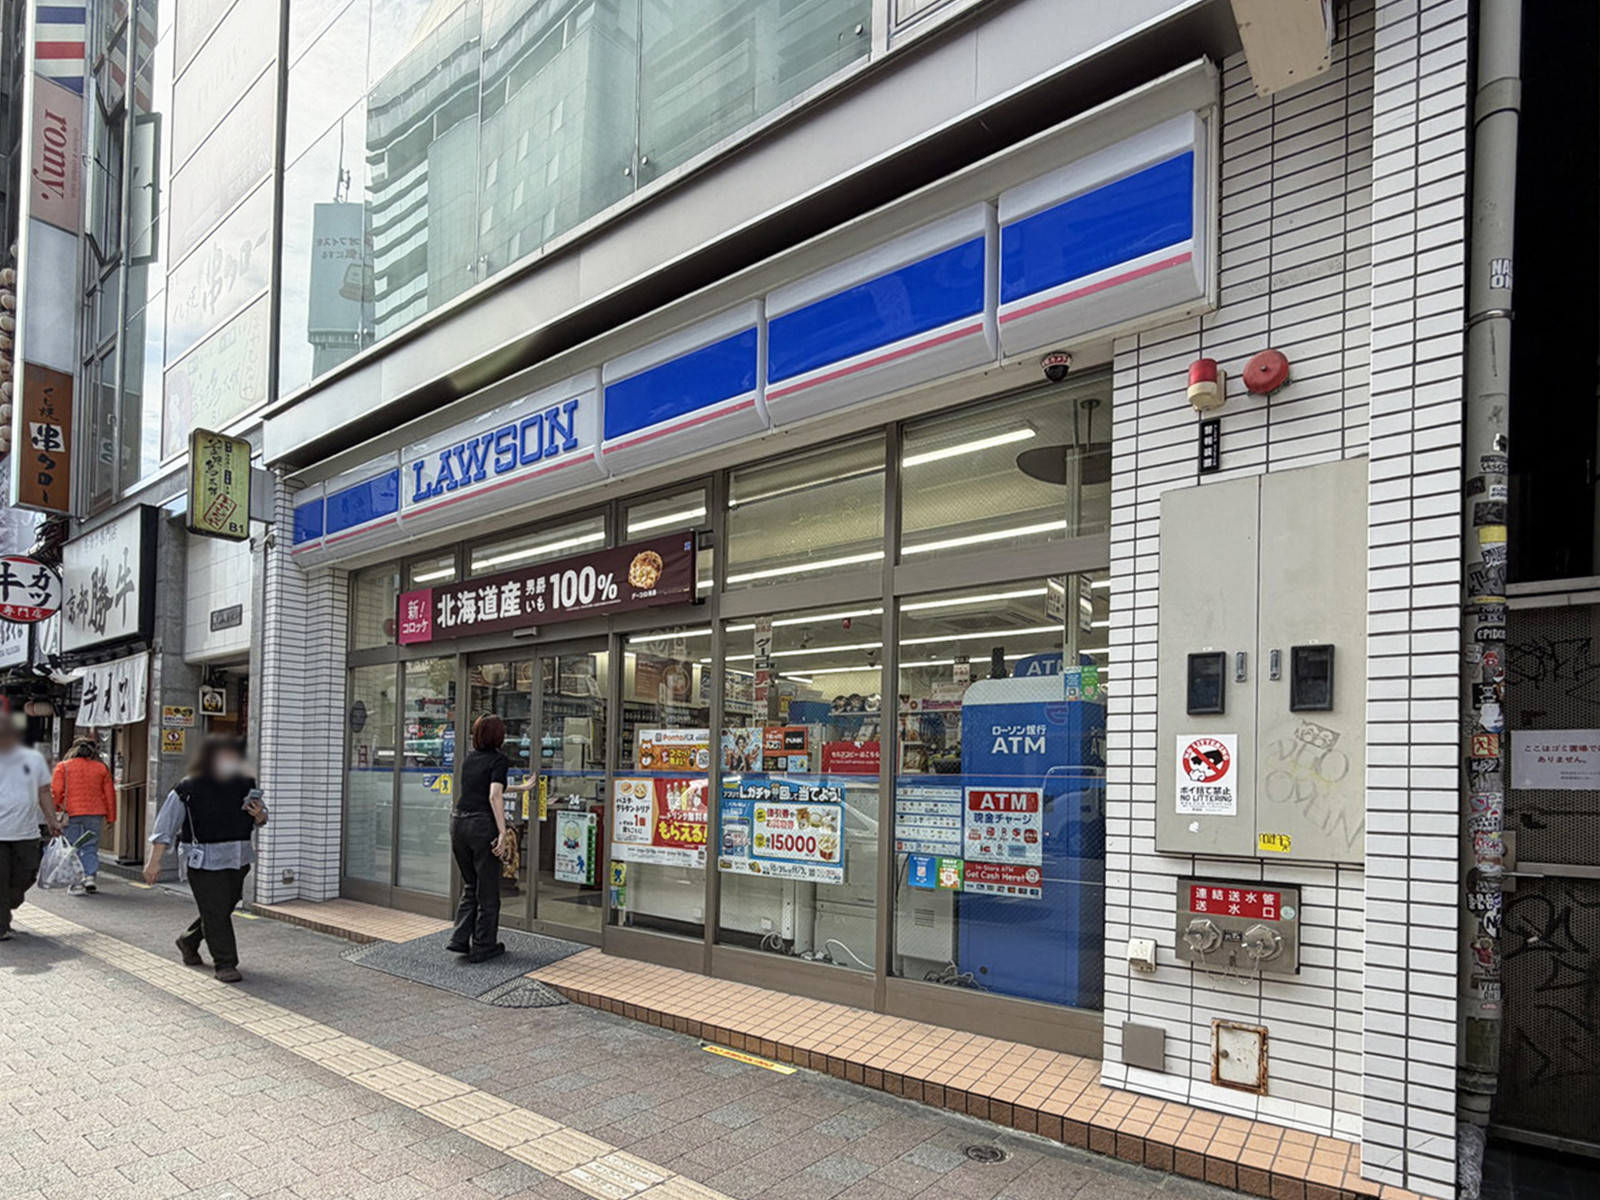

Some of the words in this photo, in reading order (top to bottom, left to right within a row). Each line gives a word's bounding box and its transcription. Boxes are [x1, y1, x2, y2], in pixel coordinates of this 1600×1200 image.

[412, 398, 579, 503] LAWSON
[228, 522, 245, 533] B1
[525, 576, 547, 596] 男爵
[549, 565, 619, 610] 100%
[436, 580, 522, 629] 北海道産
[525, 595, 547, 614] いも
[402, 618, 429, 635] コロッケ
[1026, 659, 1063, 677] AT
[992, 725, 1046, 736] ローソン銀行
[991, 736, 1046, 755] ATM
[1180, 786, 1232, 796] ポイ捨て禁止
[1180, 794, 1191, 802] NO
[1193, 795, 1232, 803] LITTERING
[980, 793, 1027, 810] ATM
[973, 812, 1032, 825] 現金チャージ
[965, 869, 979, 879] Get
[980, 871, 1001, 882] Cash
[1195, 887, 1274, 906] 連結送水管
[1195, 900, 1274, 919] 送水口
